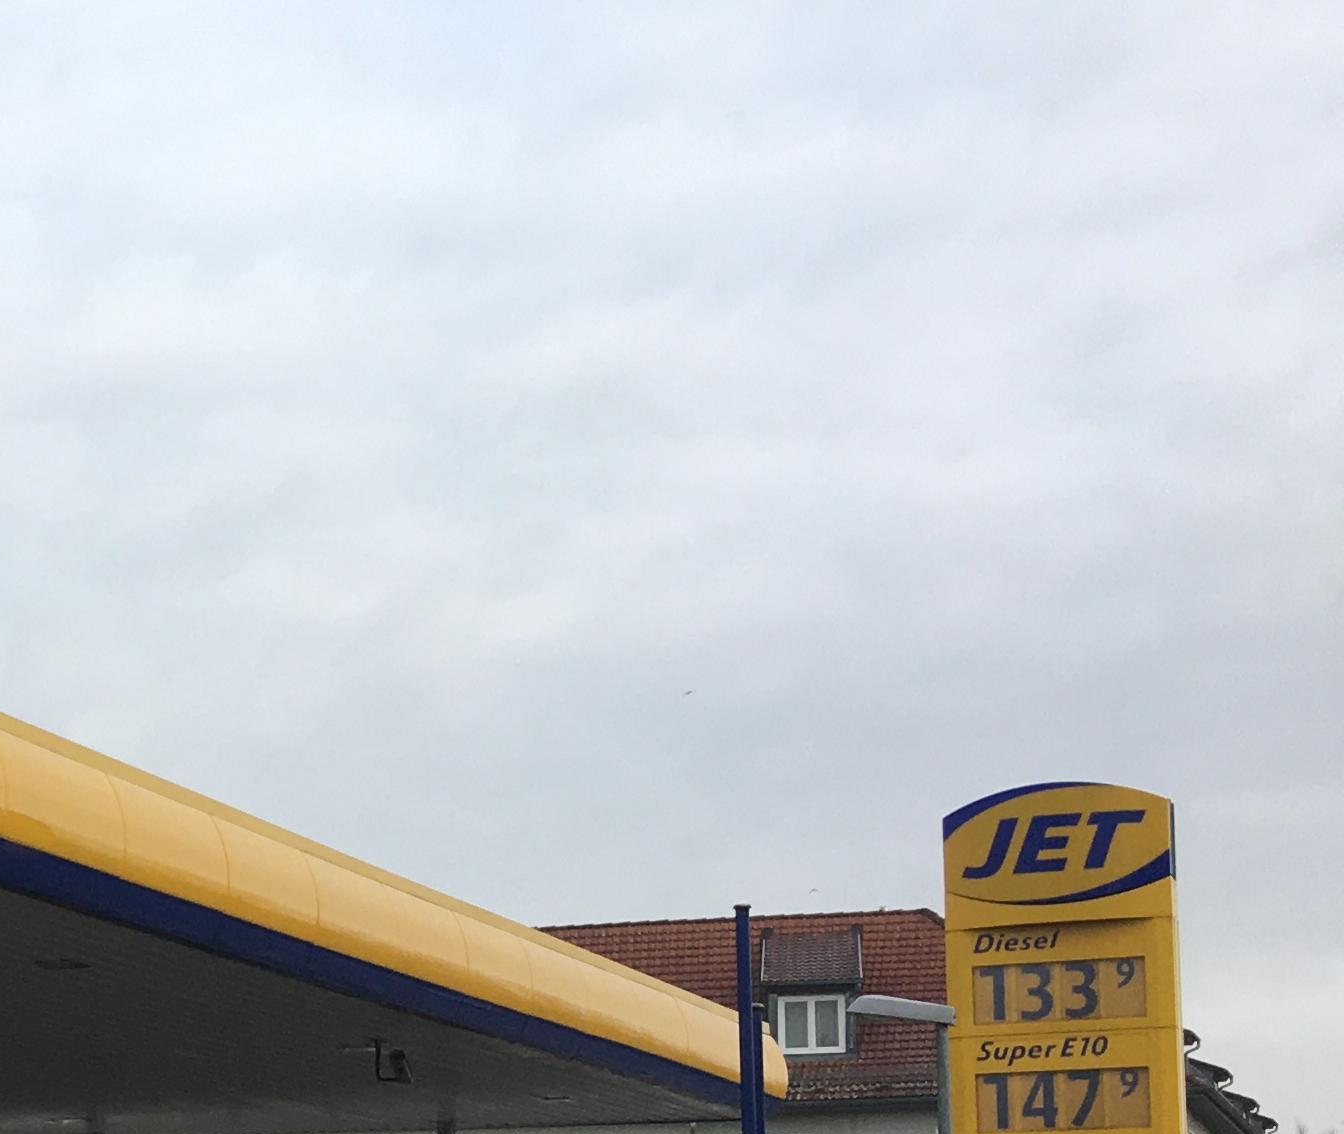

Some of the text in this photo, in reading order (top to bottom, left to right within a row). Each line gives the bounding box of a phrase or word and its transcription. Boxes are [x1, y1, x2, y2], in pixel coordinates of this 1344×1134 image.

[962, 808, 1147, 879] JET
[973, 931, 1060, 954] Diesel
[979, 959, 1098, 1021] 133
[977, 1035, 1108, 1066] Super E10
[983, 1068, 1102, 1130] 147
